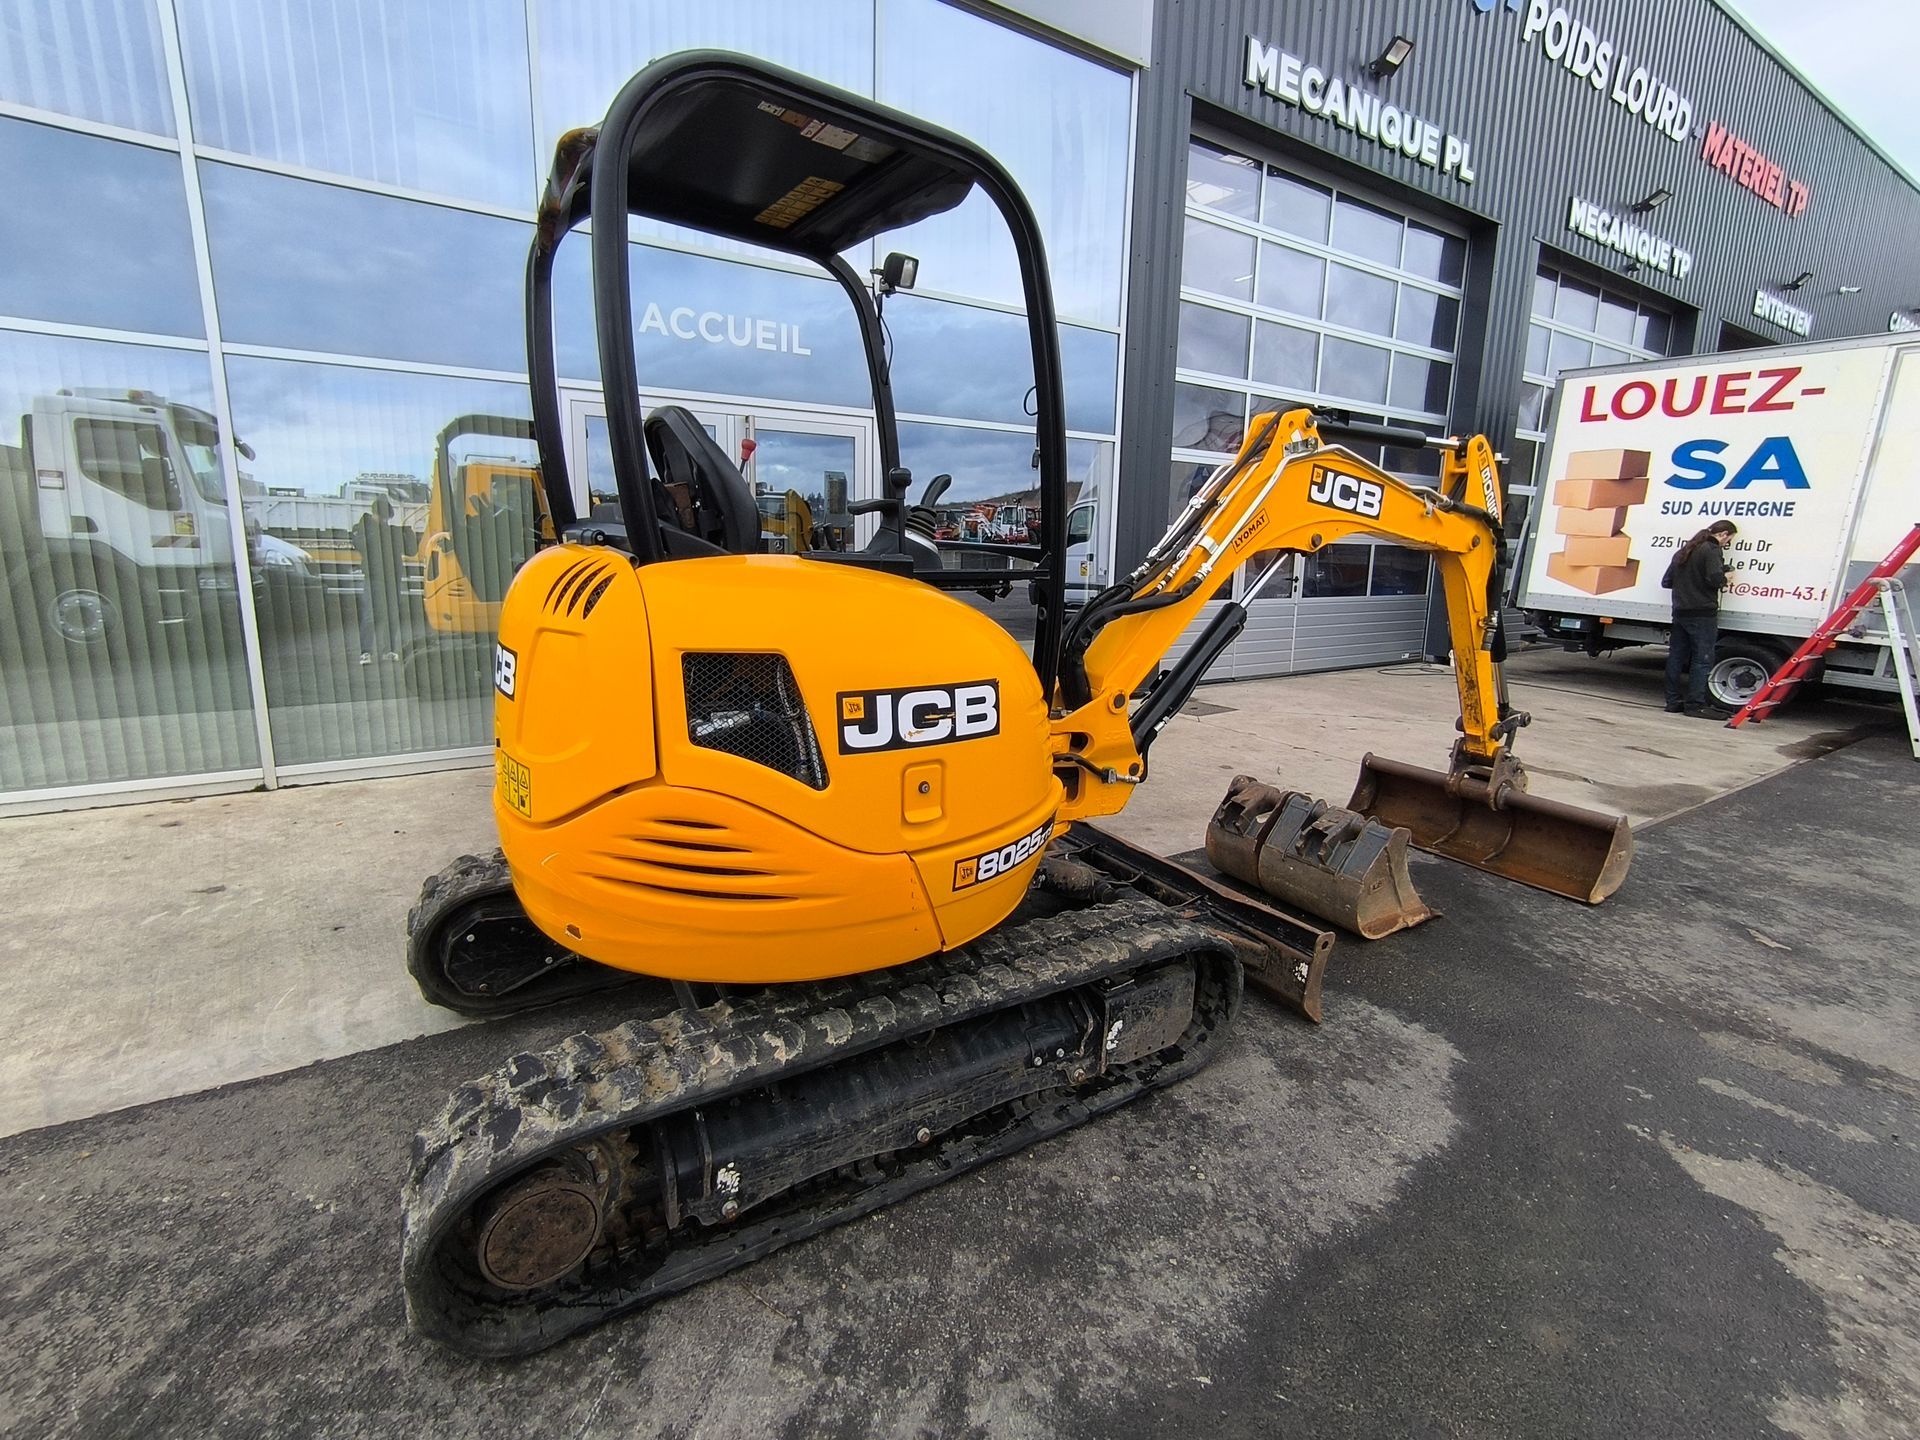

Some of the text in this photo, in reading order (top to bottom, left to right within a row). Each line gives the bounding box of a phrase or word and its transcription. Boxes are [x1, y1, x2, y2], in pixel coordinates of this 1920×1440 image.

[1523, 0, 1692, 142] POIDS LOURD
[1245, 37, 1475, 182] MECANIQUE PL
[1701, 121, 1809, 219] MATERIEL TP
[1568, 197, 1692, 280] MECANIQUE TP
[638, 302, 812, 356] ACCUEIL
[1753, 289, 1814, 337] ENTRETIEN
[1580, 366, 1826, 423] LOUEZ-
[1663, 436, 1811, 490] SA
[1311, 471, 1382, 517] JCB
[1660, 500, 1796, 517] SUD AUVERGNE
[1234, 514, 1266, 548] LYOMAT
[1650, 536, 1674, 548] 225
[1735, 540, 1752, 552] du
[1756, 539, 1773, 552] Dr
[1748, 558, 1775, 575] Puy
[844, 684, 998, 748] JCB
